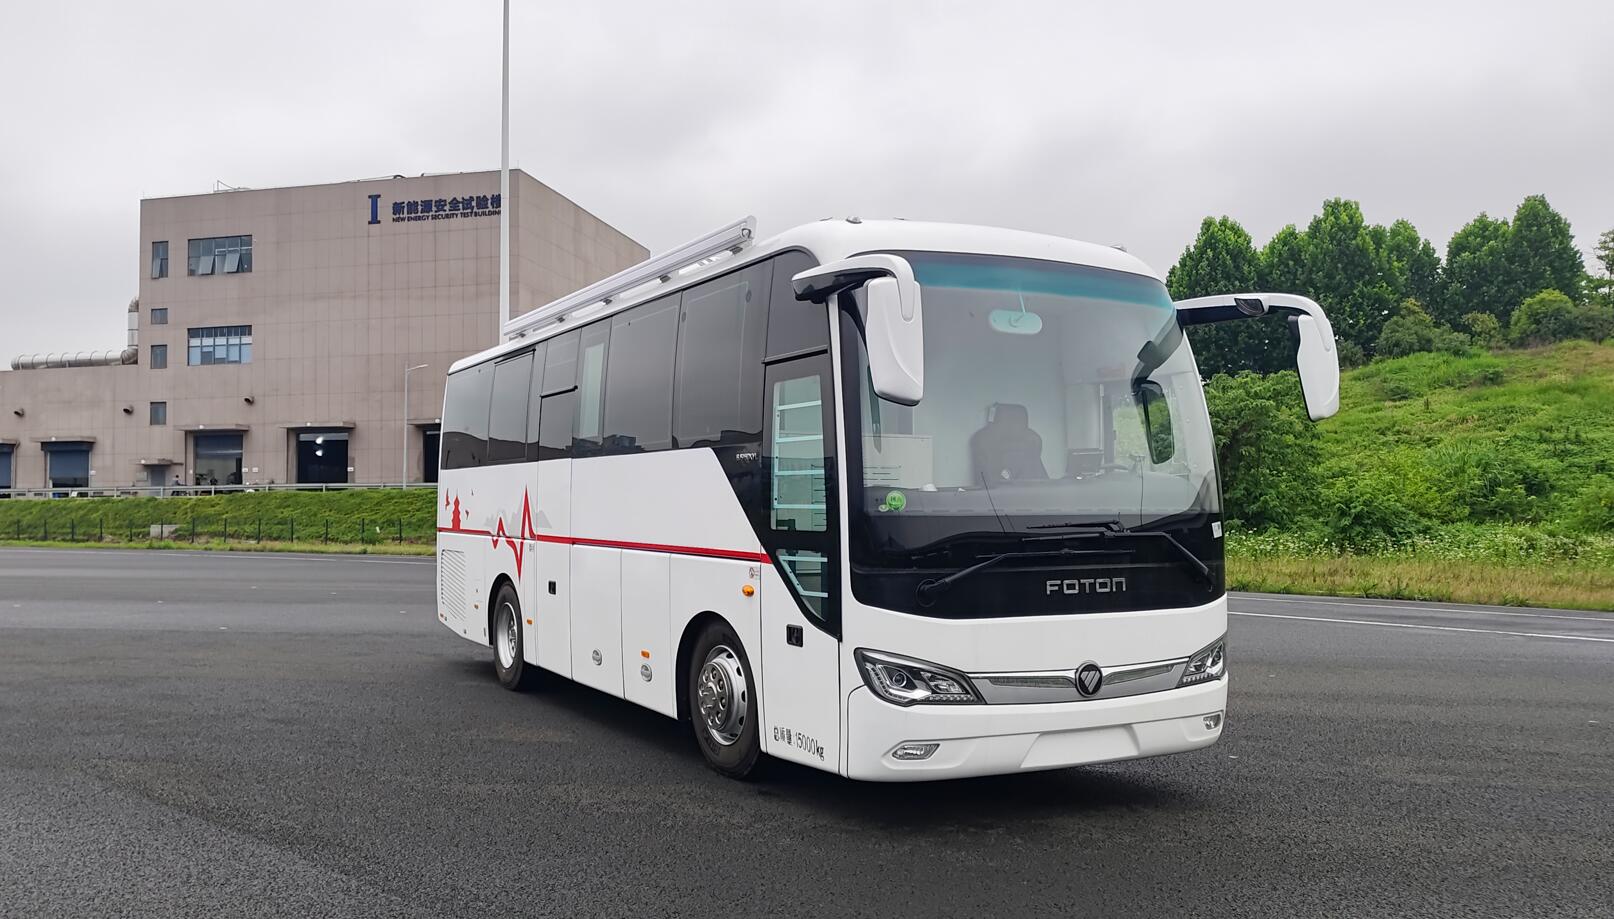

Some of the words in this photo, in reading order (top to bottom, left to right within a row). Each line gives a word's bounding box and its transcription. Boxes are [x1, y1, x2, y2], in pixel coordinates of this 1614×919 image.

[407, 214, 430, 222] ENERGY
[431, 212, 459, 221] SECURITY
[473, 209, 501, 217] BUILDIN
[1046, 577, 1126, 595] FOTON
